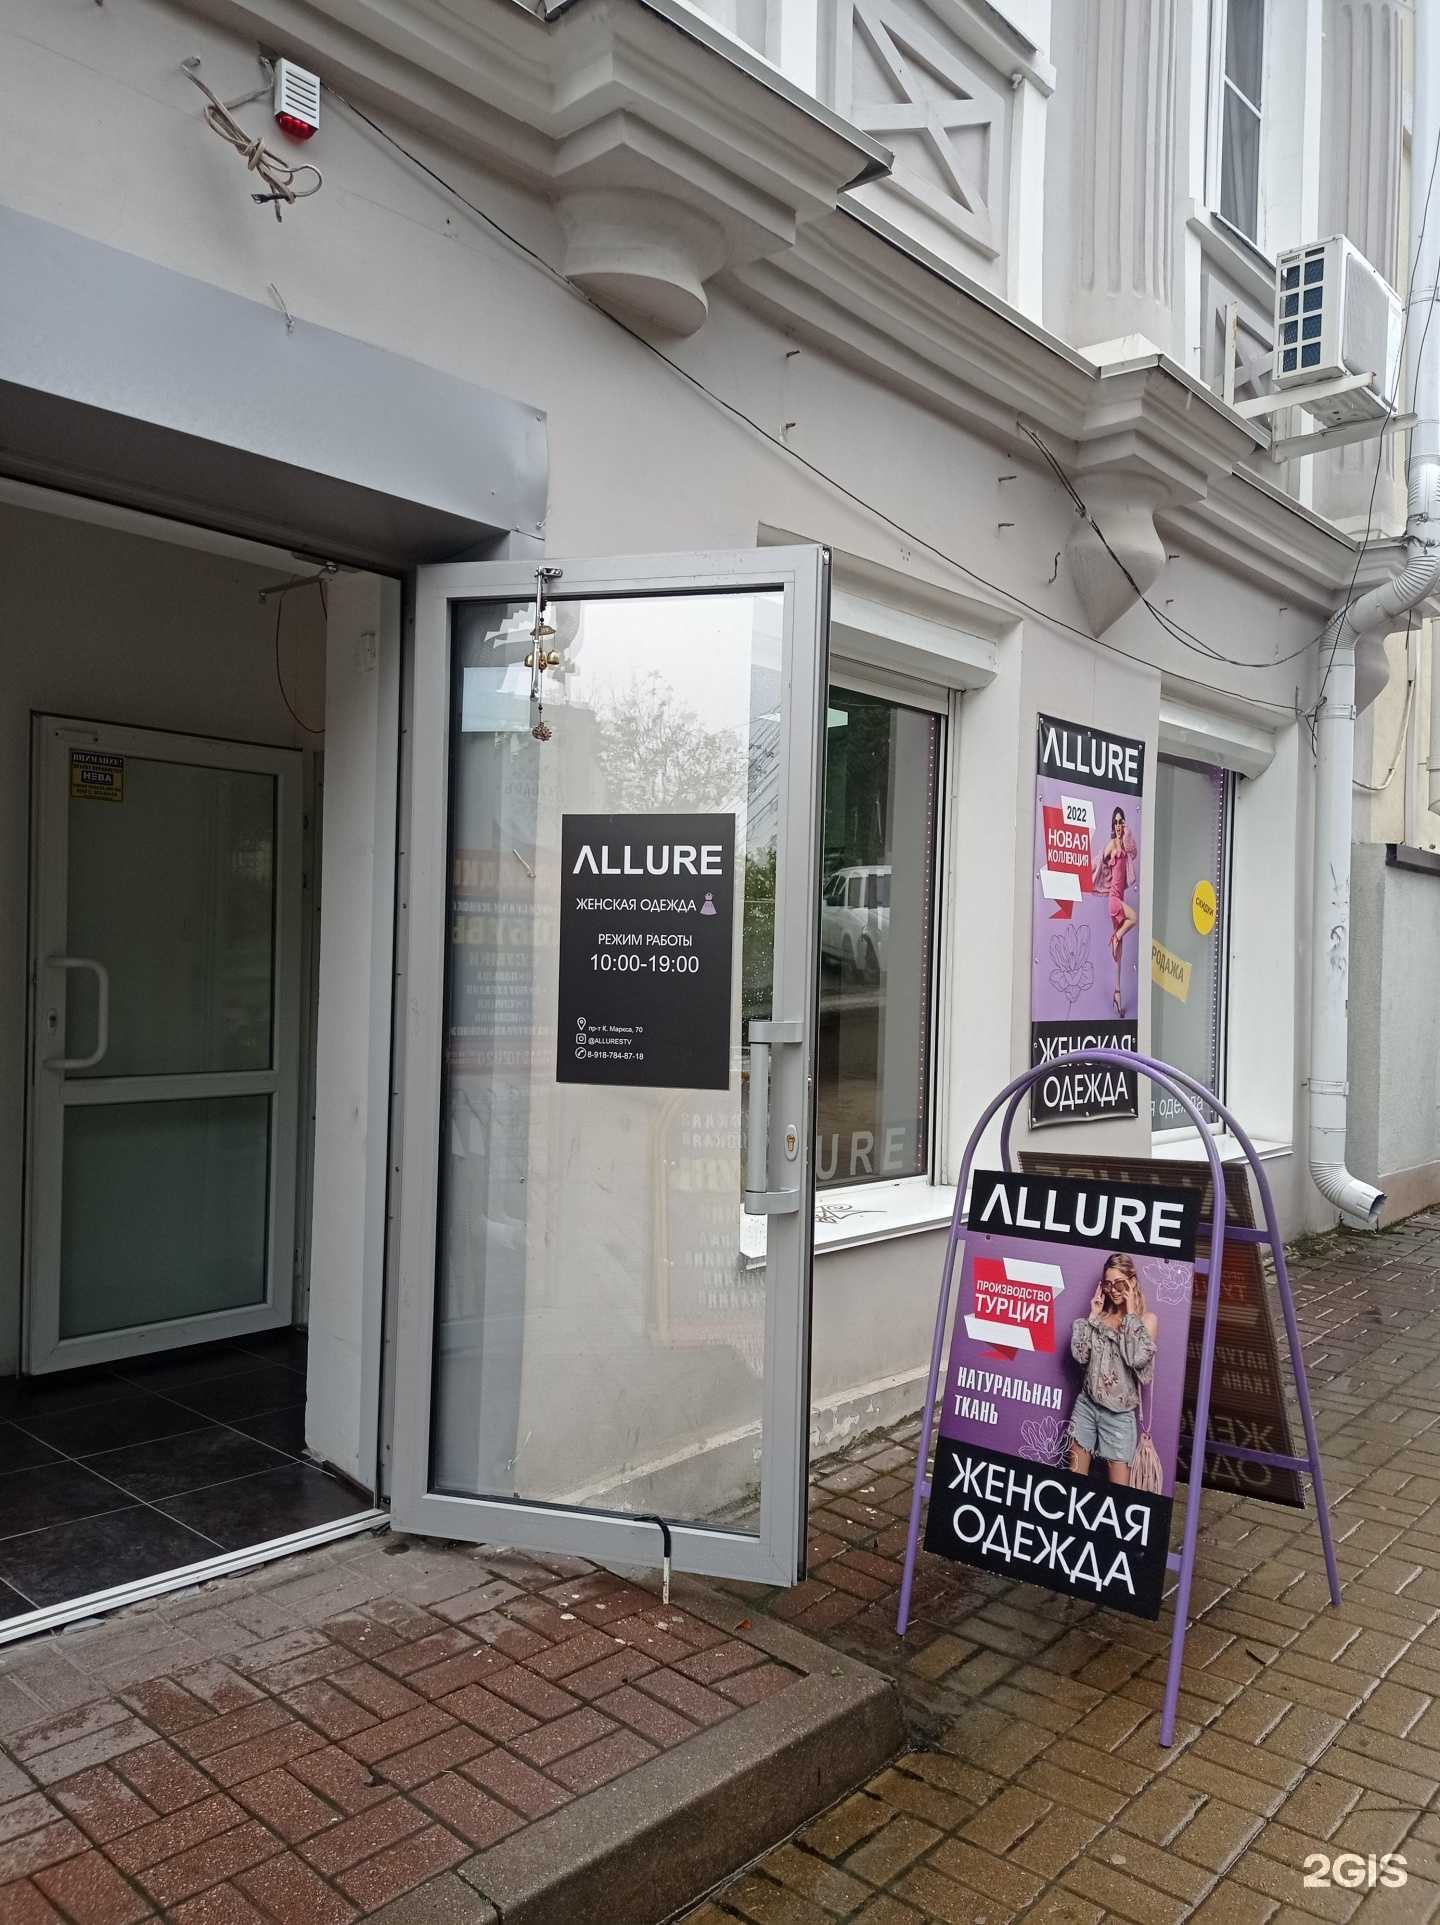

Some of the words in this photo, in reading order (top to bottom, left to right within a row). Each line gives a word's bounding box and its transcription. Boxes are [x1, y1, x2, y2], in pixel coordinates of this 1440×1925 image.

[1043, 727, 1138, 784] ALLURE
[1067, 805, 1087, 822] 2022
[1048, 828, 1089, 851] НОВАЯ
[573, 845, 723, 875] ALLURE
[1048, 849, 1089, 867] КОЛЛЕКЦИЯ
[576, 898, 637, 911] ЖЕНСКАЯ
[640, 899, 697, 913] ОДЕЖДА
[598, 934, 643, 946] РЕЖИМ
[646, 934, 693, 947] РАБОТЫ
[590, 954, 700, 973] 10:00-19:00
[1043, 1072, 1128, 1111] ОДЕЖДА
[980, 1183, 1185, 1248] ALLURE
[976, 1280, 1052, 1302] ПРОИЗВОДСТВО
[975, 1294, 1049, 1324] ТУРЦИЯ
[957, 1366, 1063, 1410] НАТУРАЛЬНАЯ
[954, 1394, 999, 1424] ТКАНЬ
[948, 1452, 1151, 1546] ЖЕНСКАЯ
[953, 1504, 1137, 1596] ОДЕЖДА
